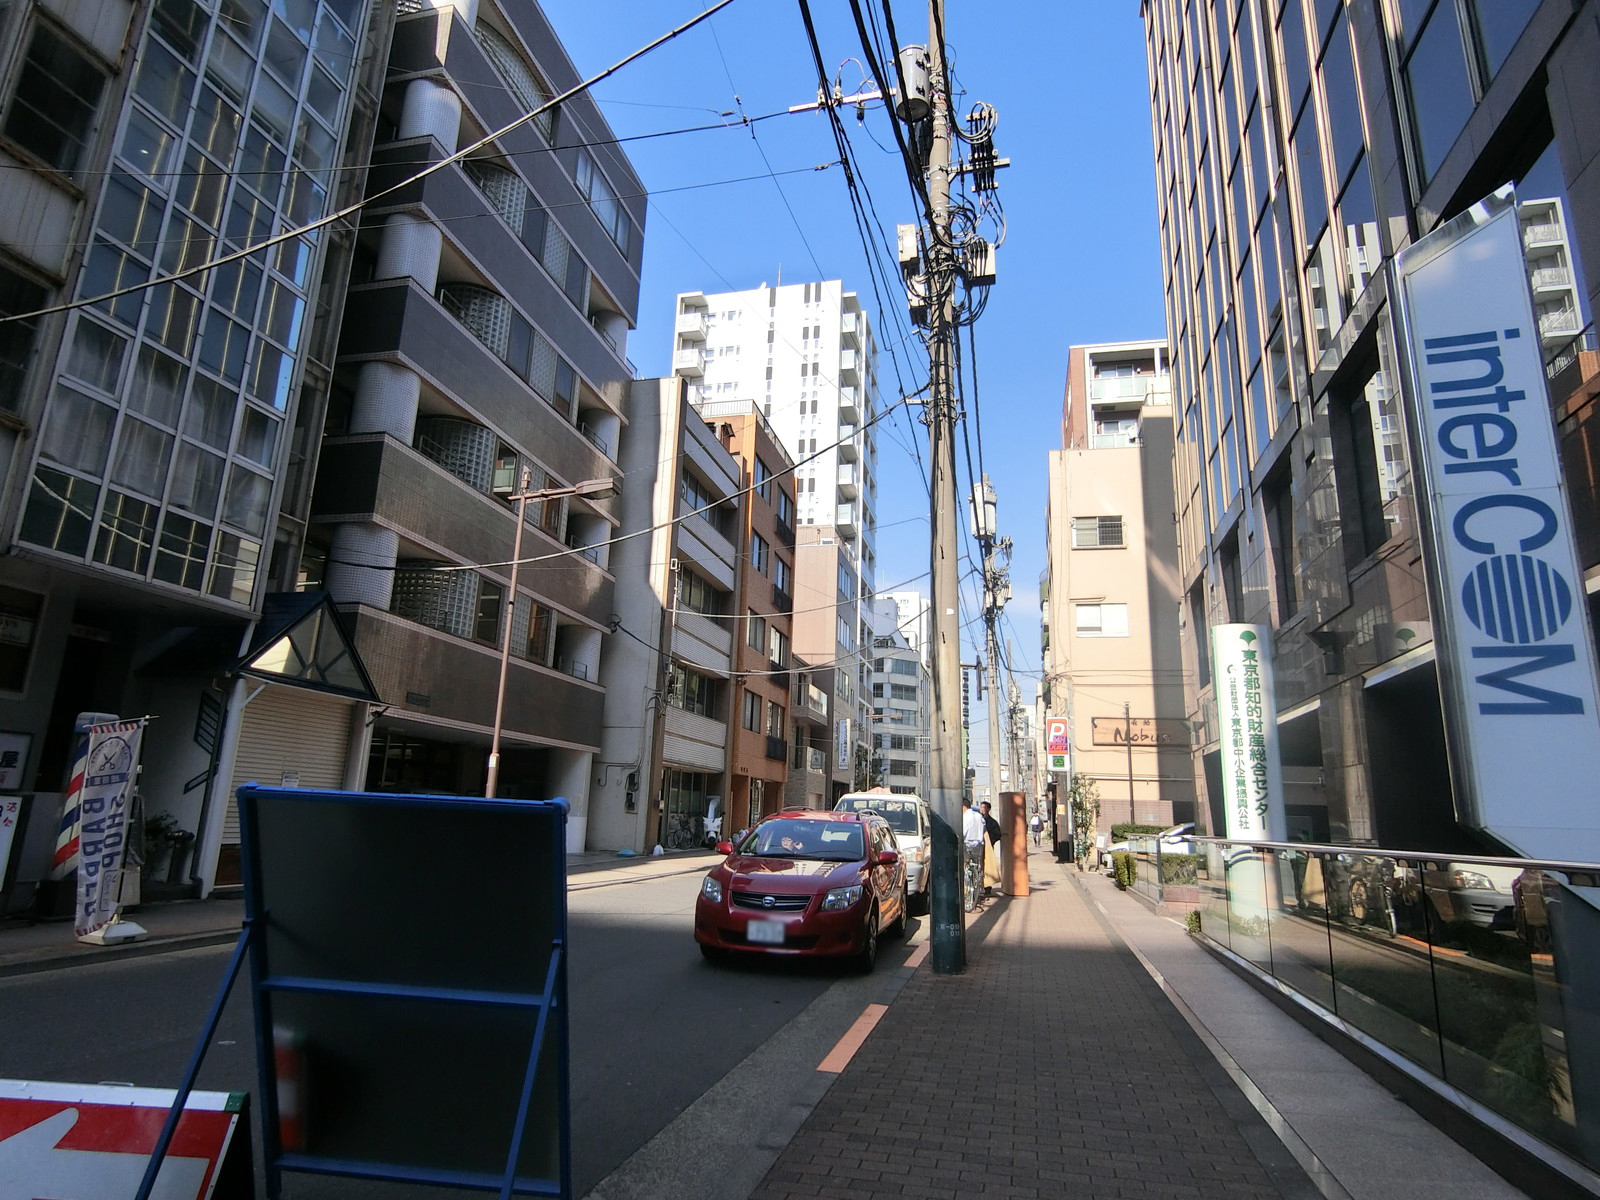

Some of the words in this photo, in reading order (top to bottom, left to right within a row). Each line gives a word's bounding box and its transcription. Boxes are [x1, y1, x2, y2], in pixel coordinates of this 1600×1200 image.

[1048, 722, 1066, 743] P
[1241, 649, 1269, 830] 東京都知的財産総合センター
